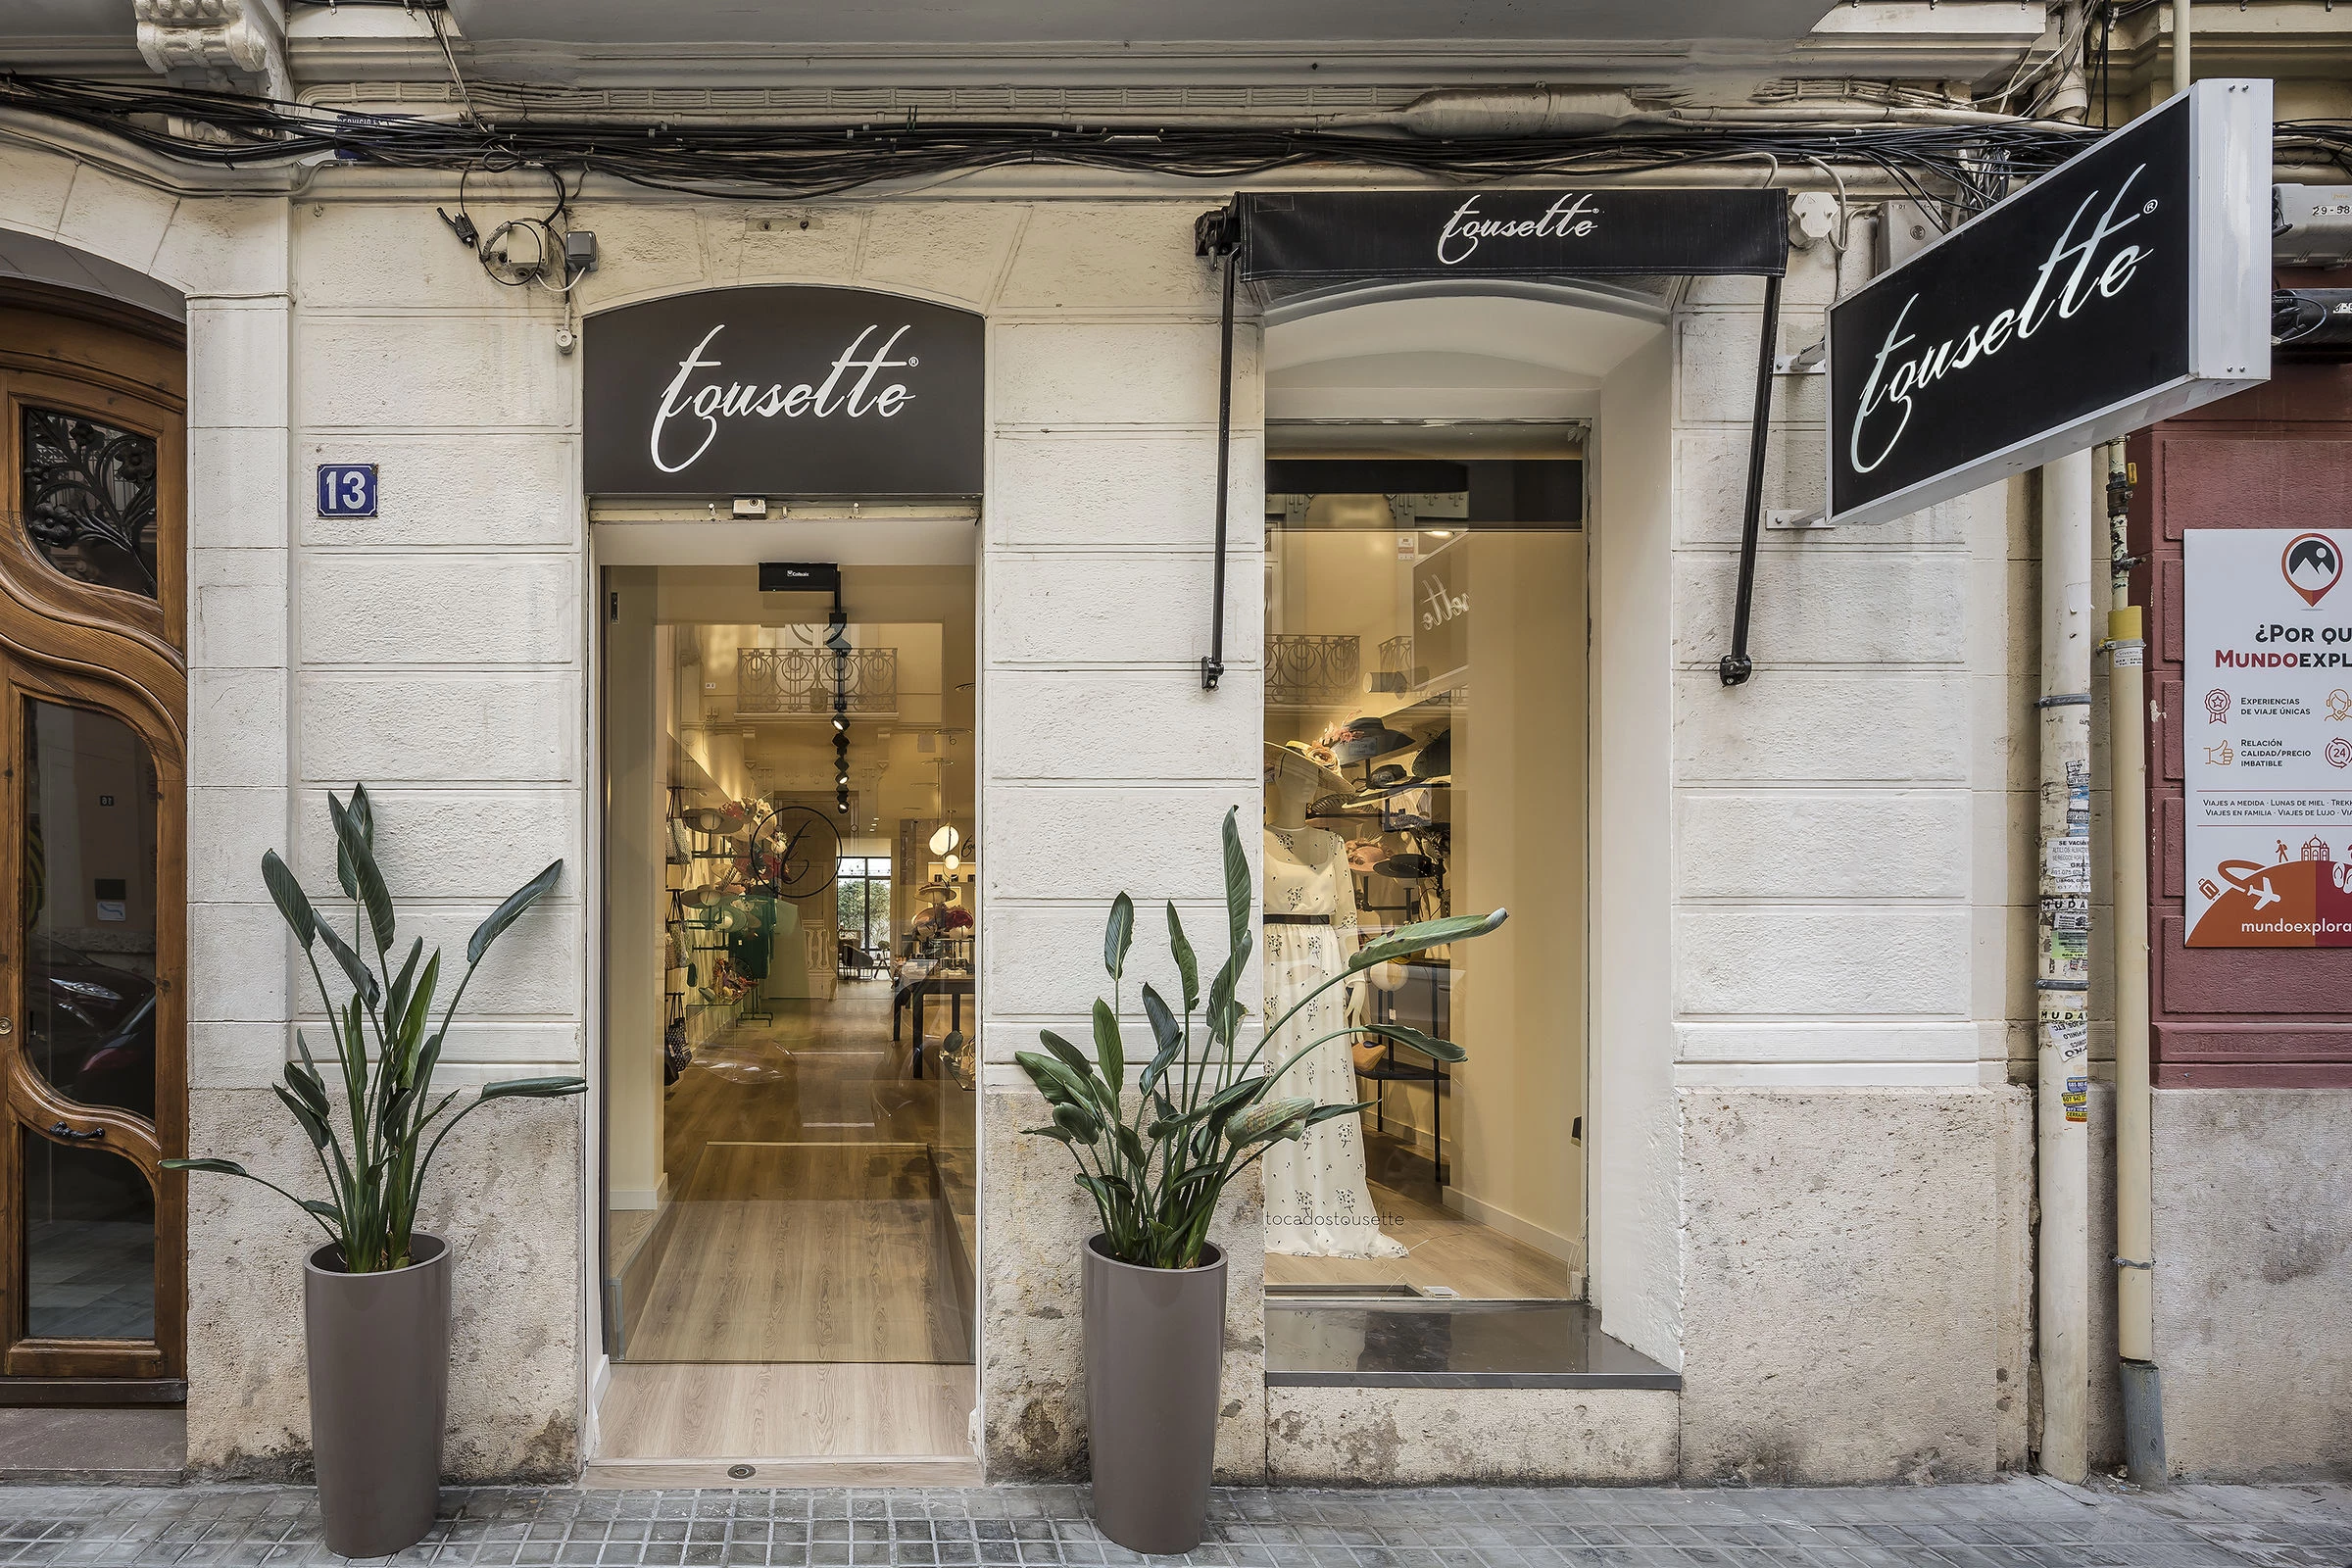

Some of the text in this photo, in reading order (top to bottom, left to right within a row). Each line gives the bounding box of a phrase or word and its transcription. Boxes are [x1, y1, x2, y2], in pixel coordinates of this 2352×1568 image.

[326, 471, 366, 510] 13
[2279, 706, 2311, 715] ÚNICAS
[2240, 738, 2282, 747] RELACIÓN
[2333, 748, 2345, 758] 24
[2241, 917, 2352, 936] mundoexplora
[1265, 1211, 1404, 1226] tocadostousette
